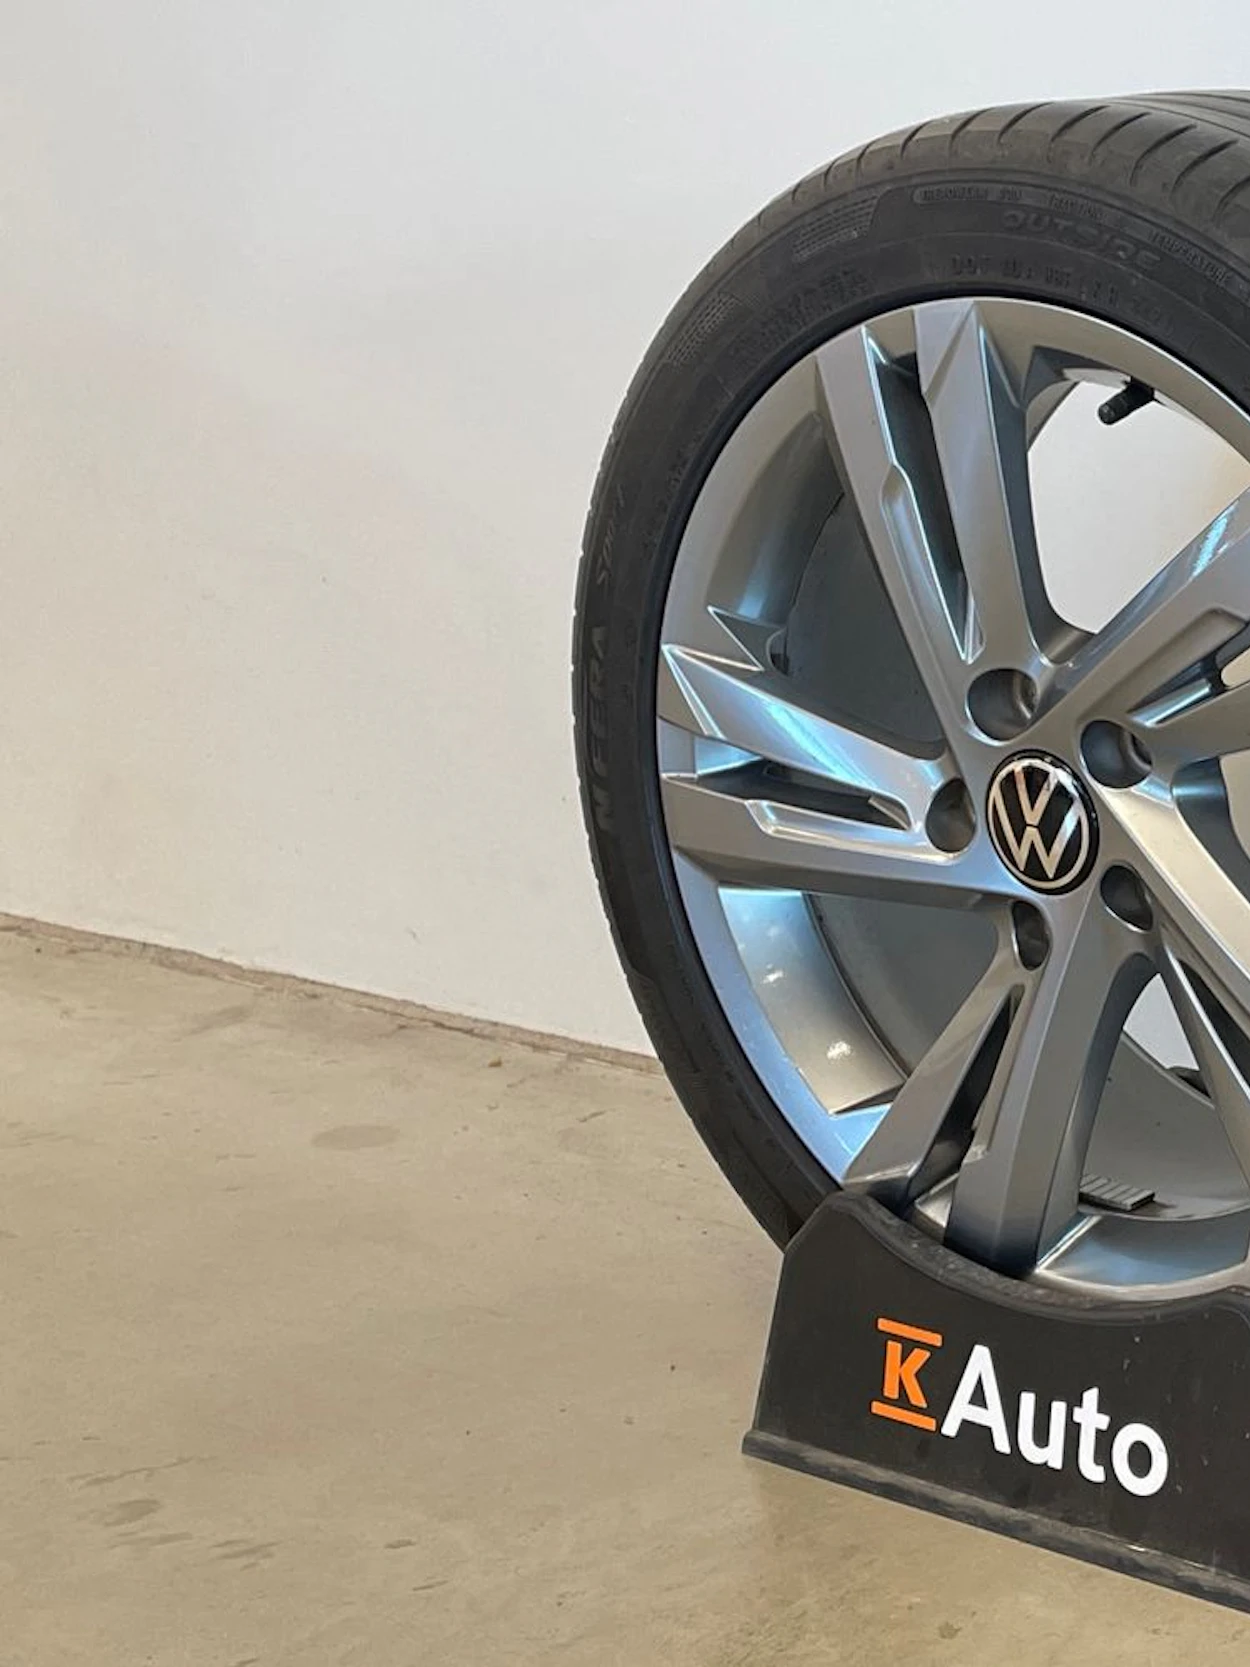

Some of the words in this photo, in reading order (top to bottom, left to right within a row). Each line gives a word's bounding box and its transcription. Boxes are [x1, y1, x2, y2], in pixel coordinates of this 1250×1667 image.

[1002, 207, 1162, 272] OUTSIDE
[988, 760, 1088, 884] VW
[940, 1343, 1168, 1497] Auto
